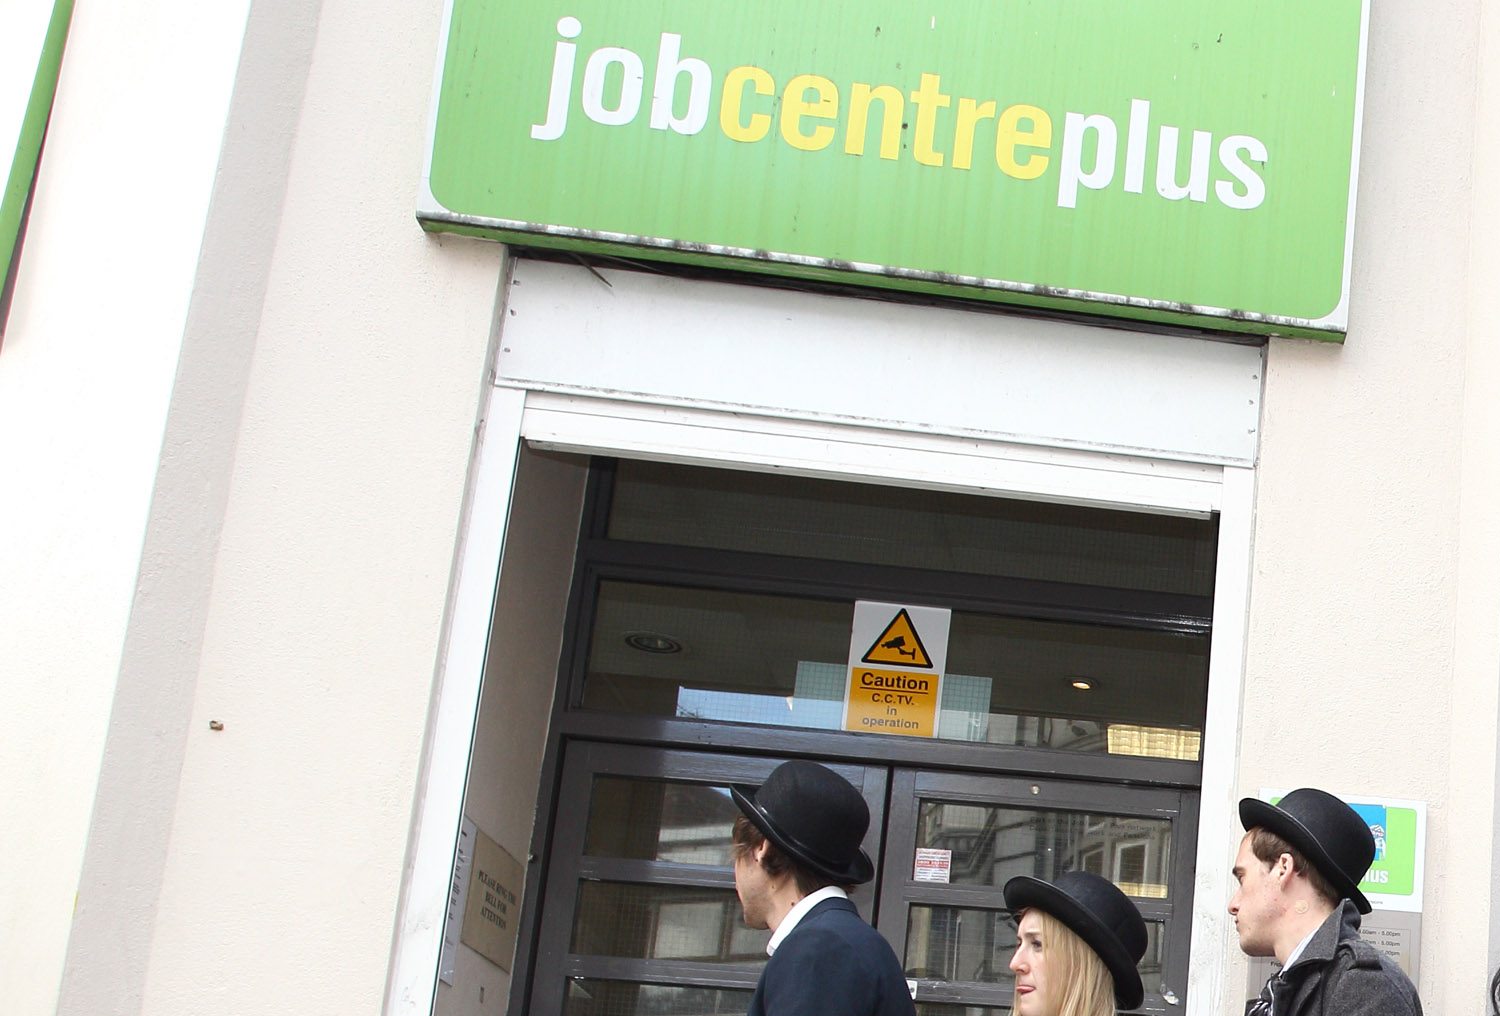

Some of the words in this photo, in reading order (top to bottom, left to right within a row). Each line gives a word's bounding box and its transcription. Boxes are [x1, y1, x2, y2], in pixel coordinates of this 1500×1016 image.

[861, 672, 929, 690] Caution
[887, 706, 897, 716] in
[862, 717, 919, 729] operation
